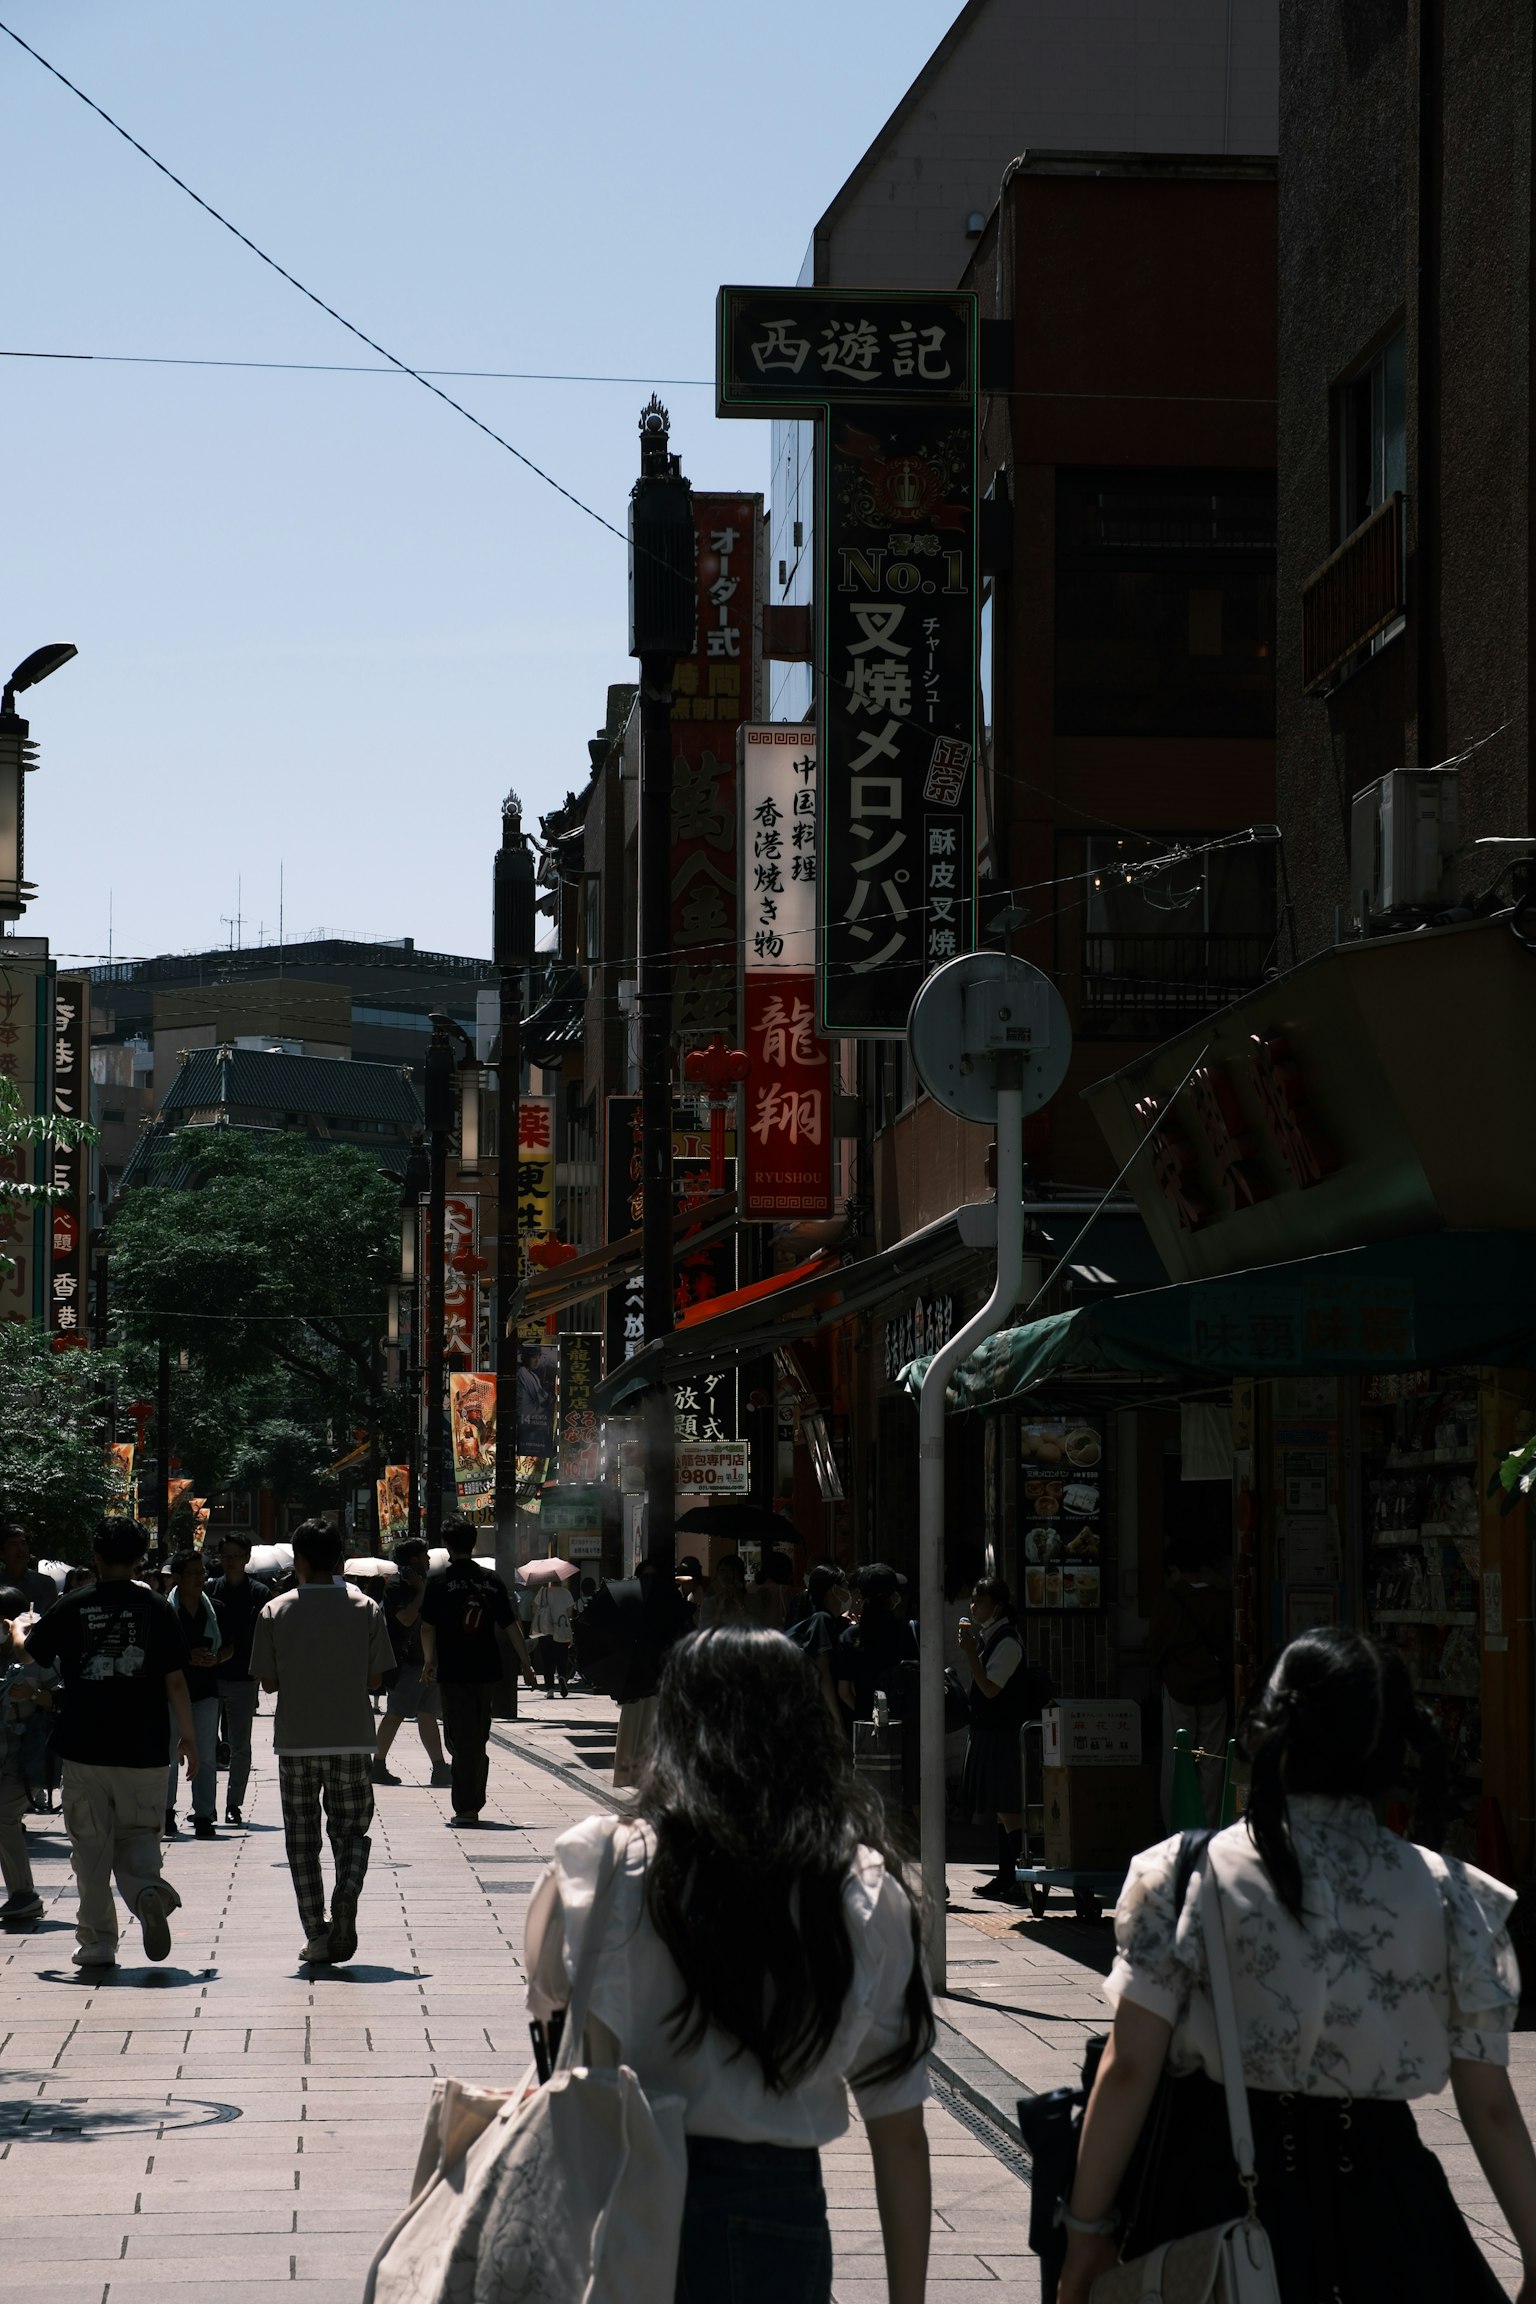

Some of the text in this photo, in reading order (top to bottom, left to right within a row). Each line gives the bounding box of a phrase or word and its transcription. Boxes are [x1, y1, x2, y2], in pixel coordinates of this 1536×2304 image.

[750, 318, 952, 382] 西遊記
[706, 527, 741, 658] オーダー式
[838, 547, 968, 594] No.1
[888, 533, 942, 557] 香港
[921, 616, 941, 723] チャーシュー
[792, 755, 817, 882] 中国料理
[843, 601, 913, 975] 叉焼メロンパン
[753, 796, 784, 958] 香港焼き物
[928, 827, 957, 975] 酥皮叉焼
[517, 1104, 551, 1149] 薬
[750, 996, 828, 1147] 龍翔
[754, 1171, 823, 1184] RYUSHOU
